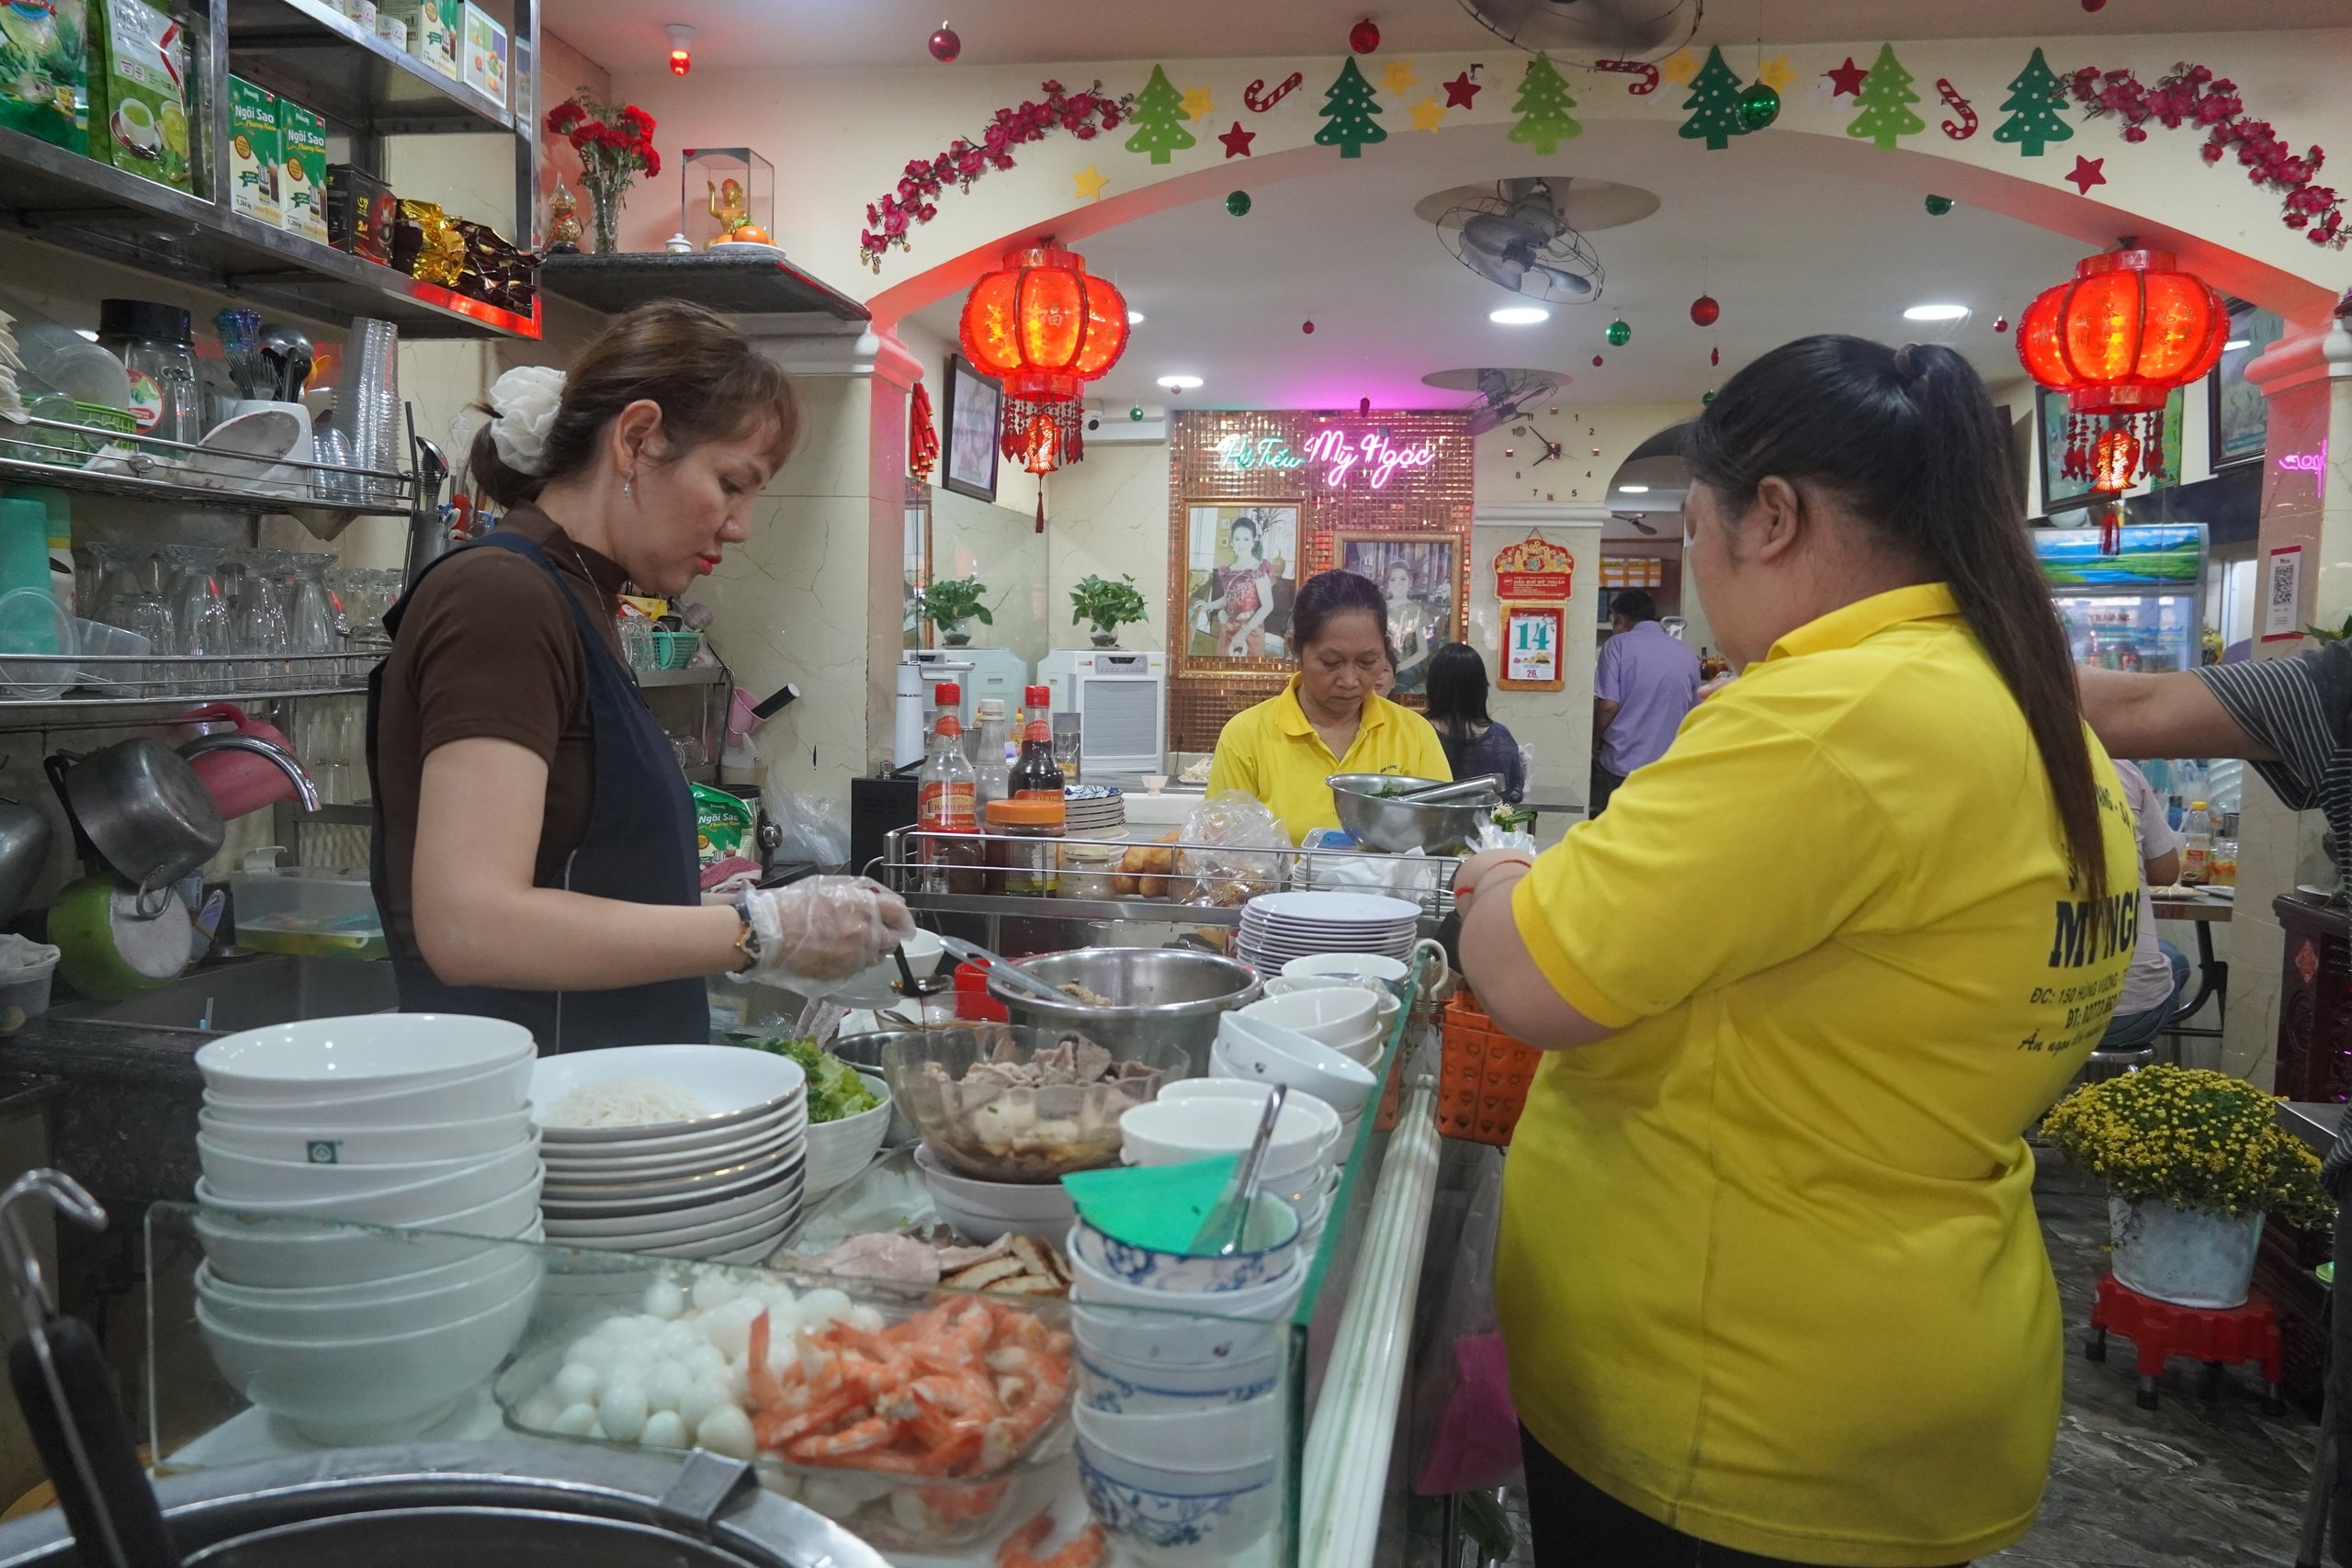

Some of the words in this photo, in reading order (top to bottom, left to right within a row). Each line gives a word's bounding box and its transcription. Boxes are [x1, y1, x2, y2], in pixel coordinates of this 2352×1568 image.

[235, 105, 254, 120] Ngôi
[256, 107, 275, 124] Sao
[288, 130, 307, 144] Ngôi
[308, 131, 324, 147] Sao
[1574, 413, 1579, 422] 1
[1589, 427, 1595, 435] 2
[1304, 430, 1359, 487] Mỹ
[1361, 433, 1436, 490] Ngọc
[1515, 471, 1521, 479] 8
[1586, 470, 1591, 479] 4
[1532, 489, 1538, 497] 7
[1571, 489, 1577, 497] 5
[1515, 622, 1551, 650] 14
[1526, 669, 1537, 678] 26
[698, 813, 721, 825] Ngôi
[722, 813, 739, 821] Sao
[2030, 987, 2056, 1004] ĐC:
[2058, 987, 2076, 1004] 150
[2065, 1008, 2082, 1029] ĐT:
[2018, 1028, 2044, 1052] Ăn
